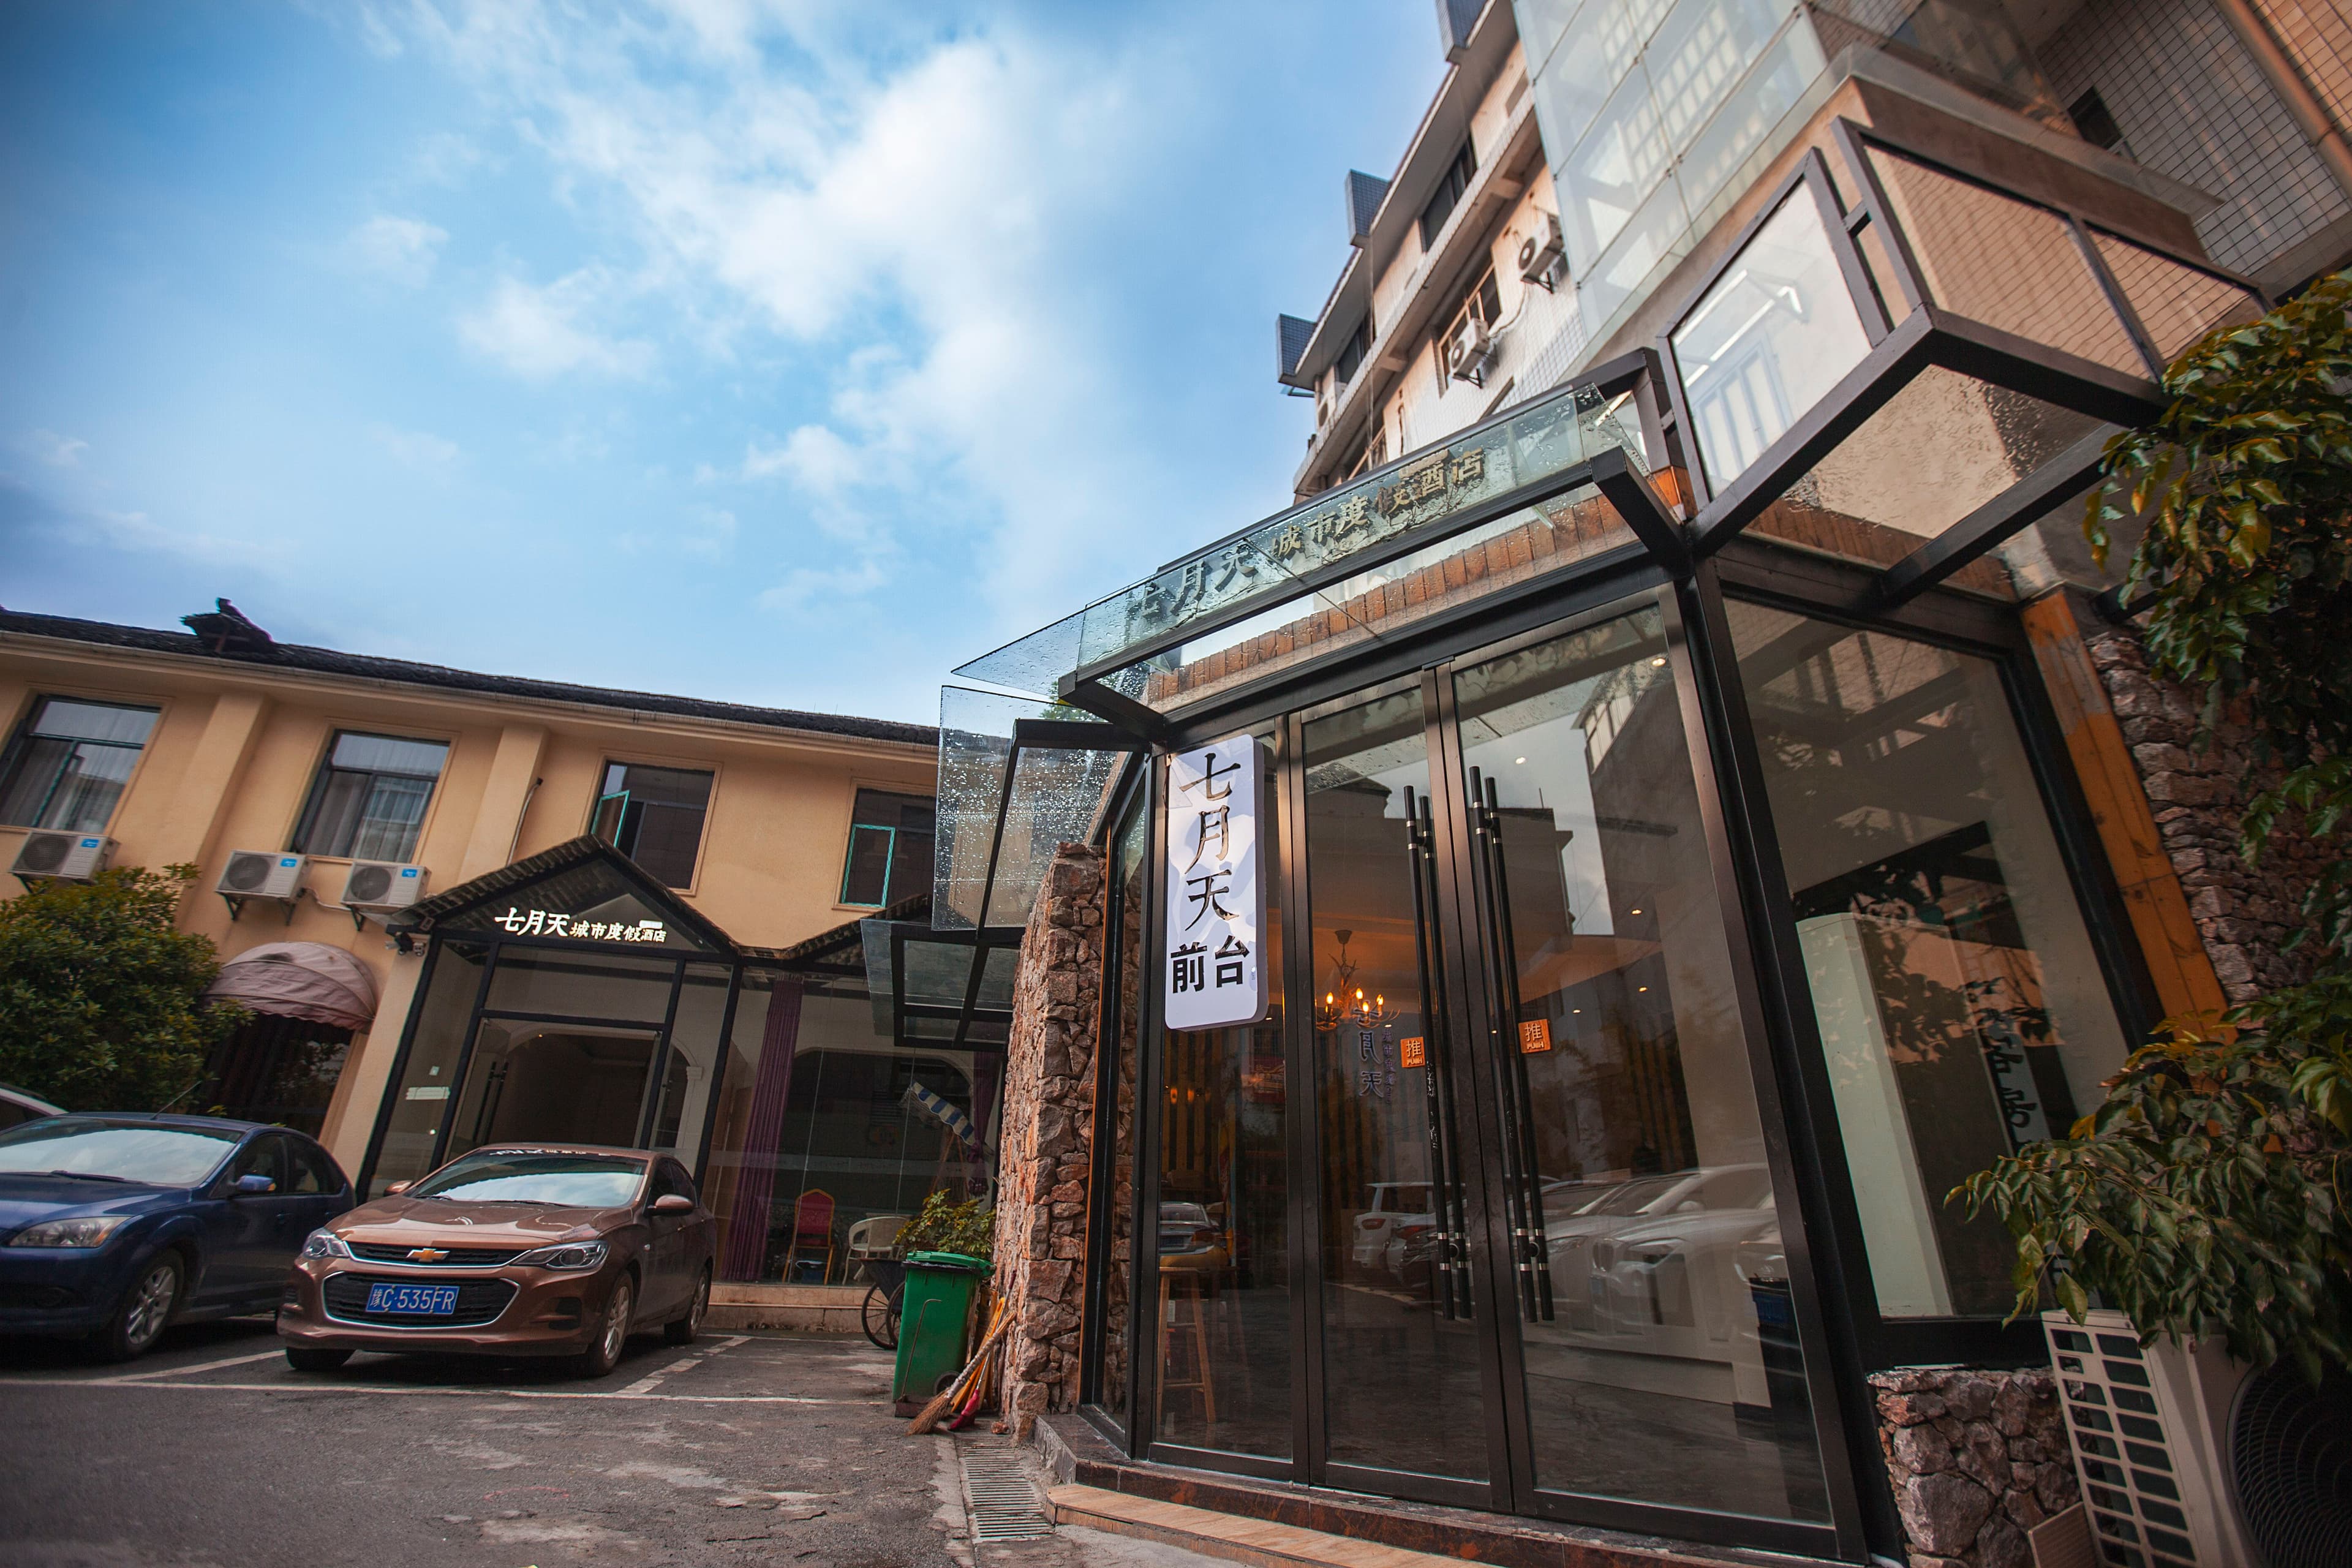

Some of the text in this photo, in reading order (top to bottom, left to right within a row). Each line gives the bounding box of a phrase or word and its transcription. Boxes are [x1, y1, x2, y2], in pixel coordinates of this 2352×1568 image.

[1180, 753, 1240, 931] 七月天
[495, 907, 666, 943] 七月天城市度假酒店
[1170, 935, 1250, 993] 前台
[1406, 1039, 1422, 1057] 推
[1524, 1023, 1542, 1041] 推
